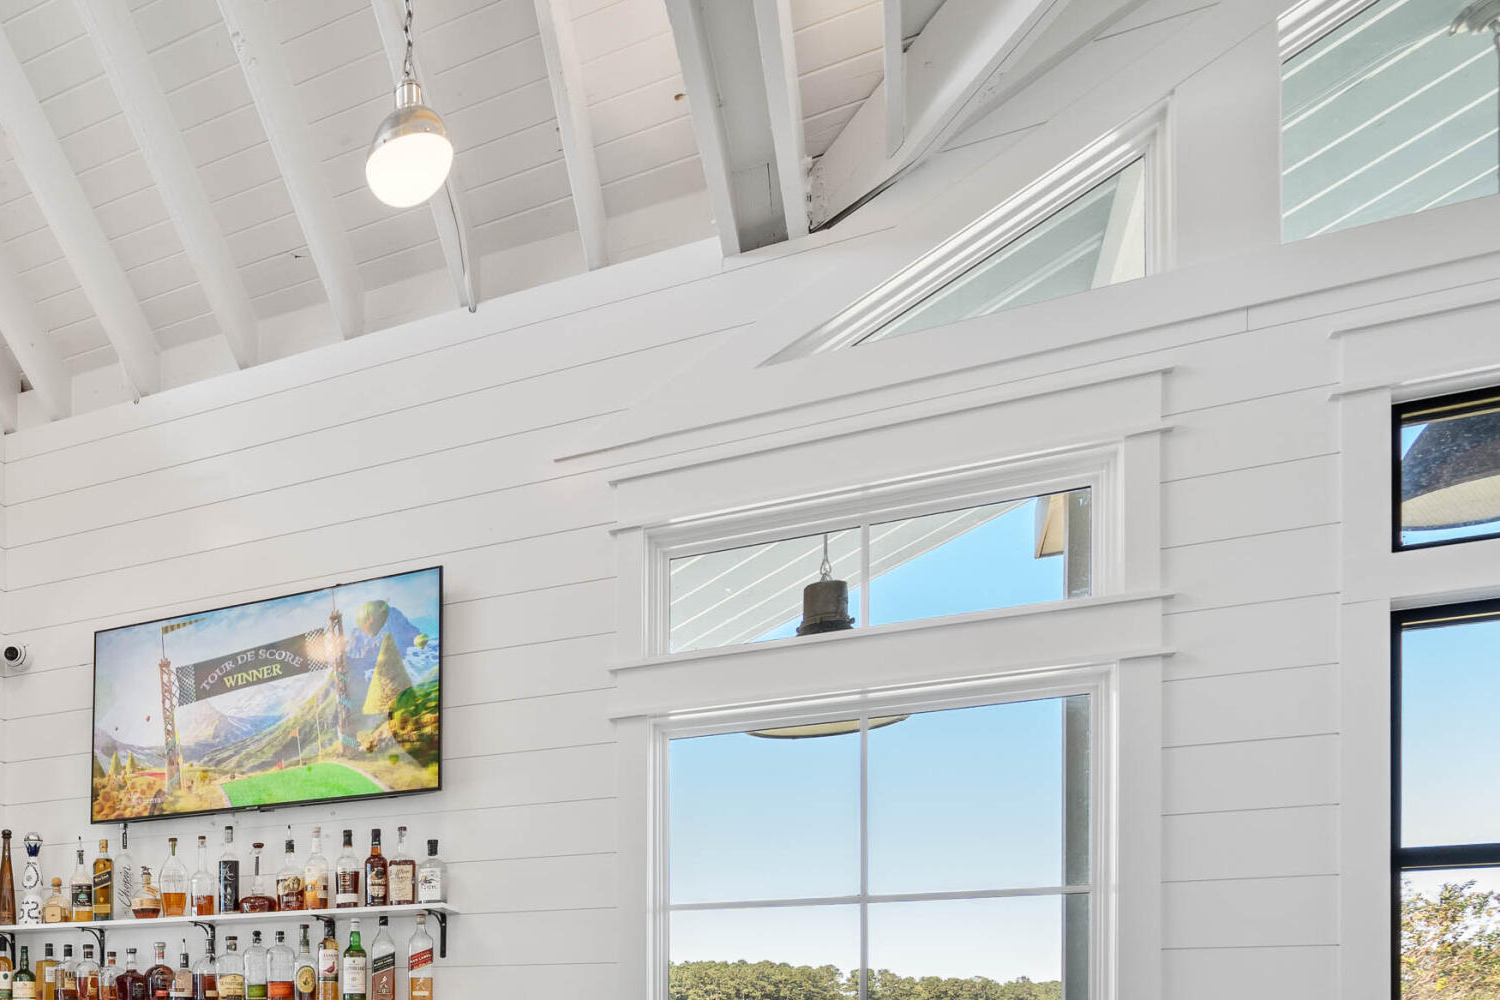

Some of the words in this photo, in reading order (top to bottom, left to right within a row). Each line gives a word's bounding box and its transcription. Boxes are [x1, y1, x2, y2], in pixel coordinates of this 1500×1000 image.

[200, 660, 235, 691] TOUR
[237, 650, 256, 665] DE
[258, 648, 304, 668] SCORE
[223, 663, 283, 688] WINNER
